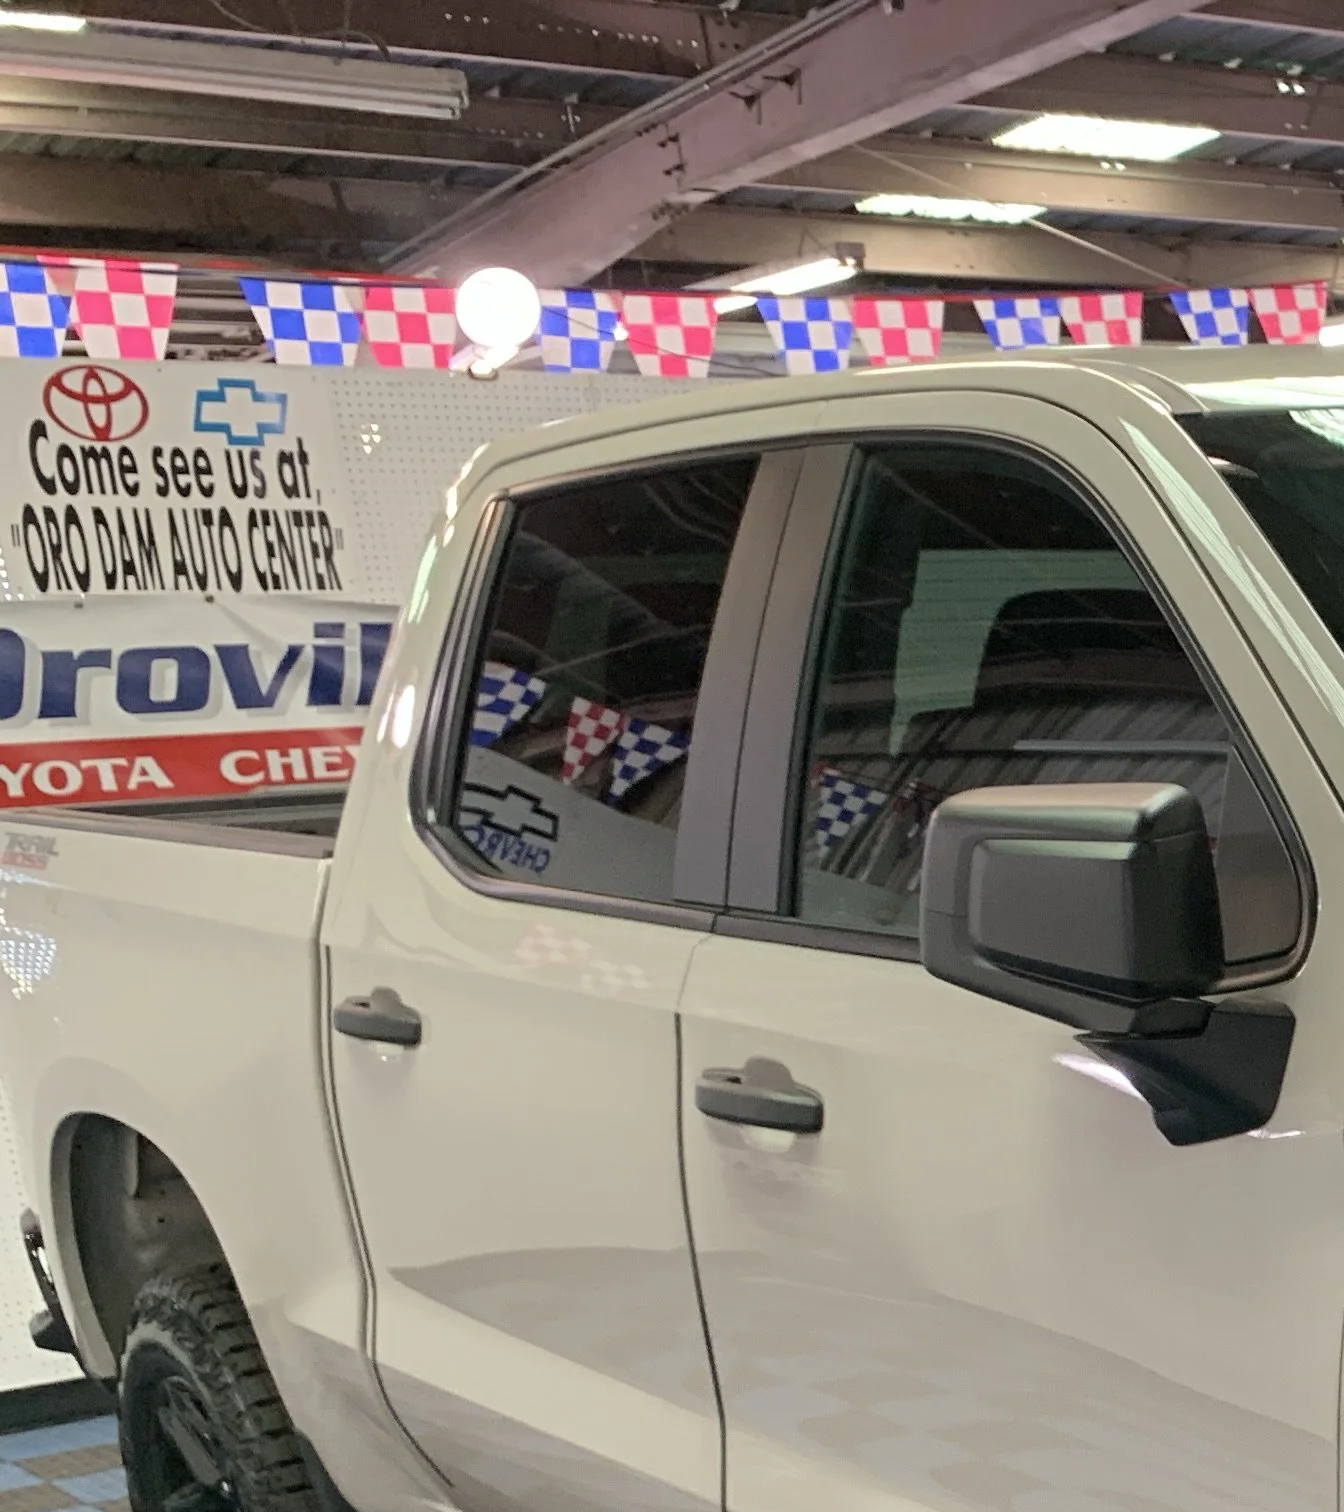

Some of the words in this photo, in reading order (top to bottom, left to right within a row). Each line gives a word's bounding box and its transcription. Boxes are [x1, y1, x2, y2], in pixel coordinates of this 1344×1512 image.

[28, 418, 140, 497] Come
[152, 445, 216, 498] see
[224, 448, 267, 499] us
[92, 506, 165, 591] DAM
[168, 505, 243, 593] AUTO
[0, 622, 393, 719] rovil
